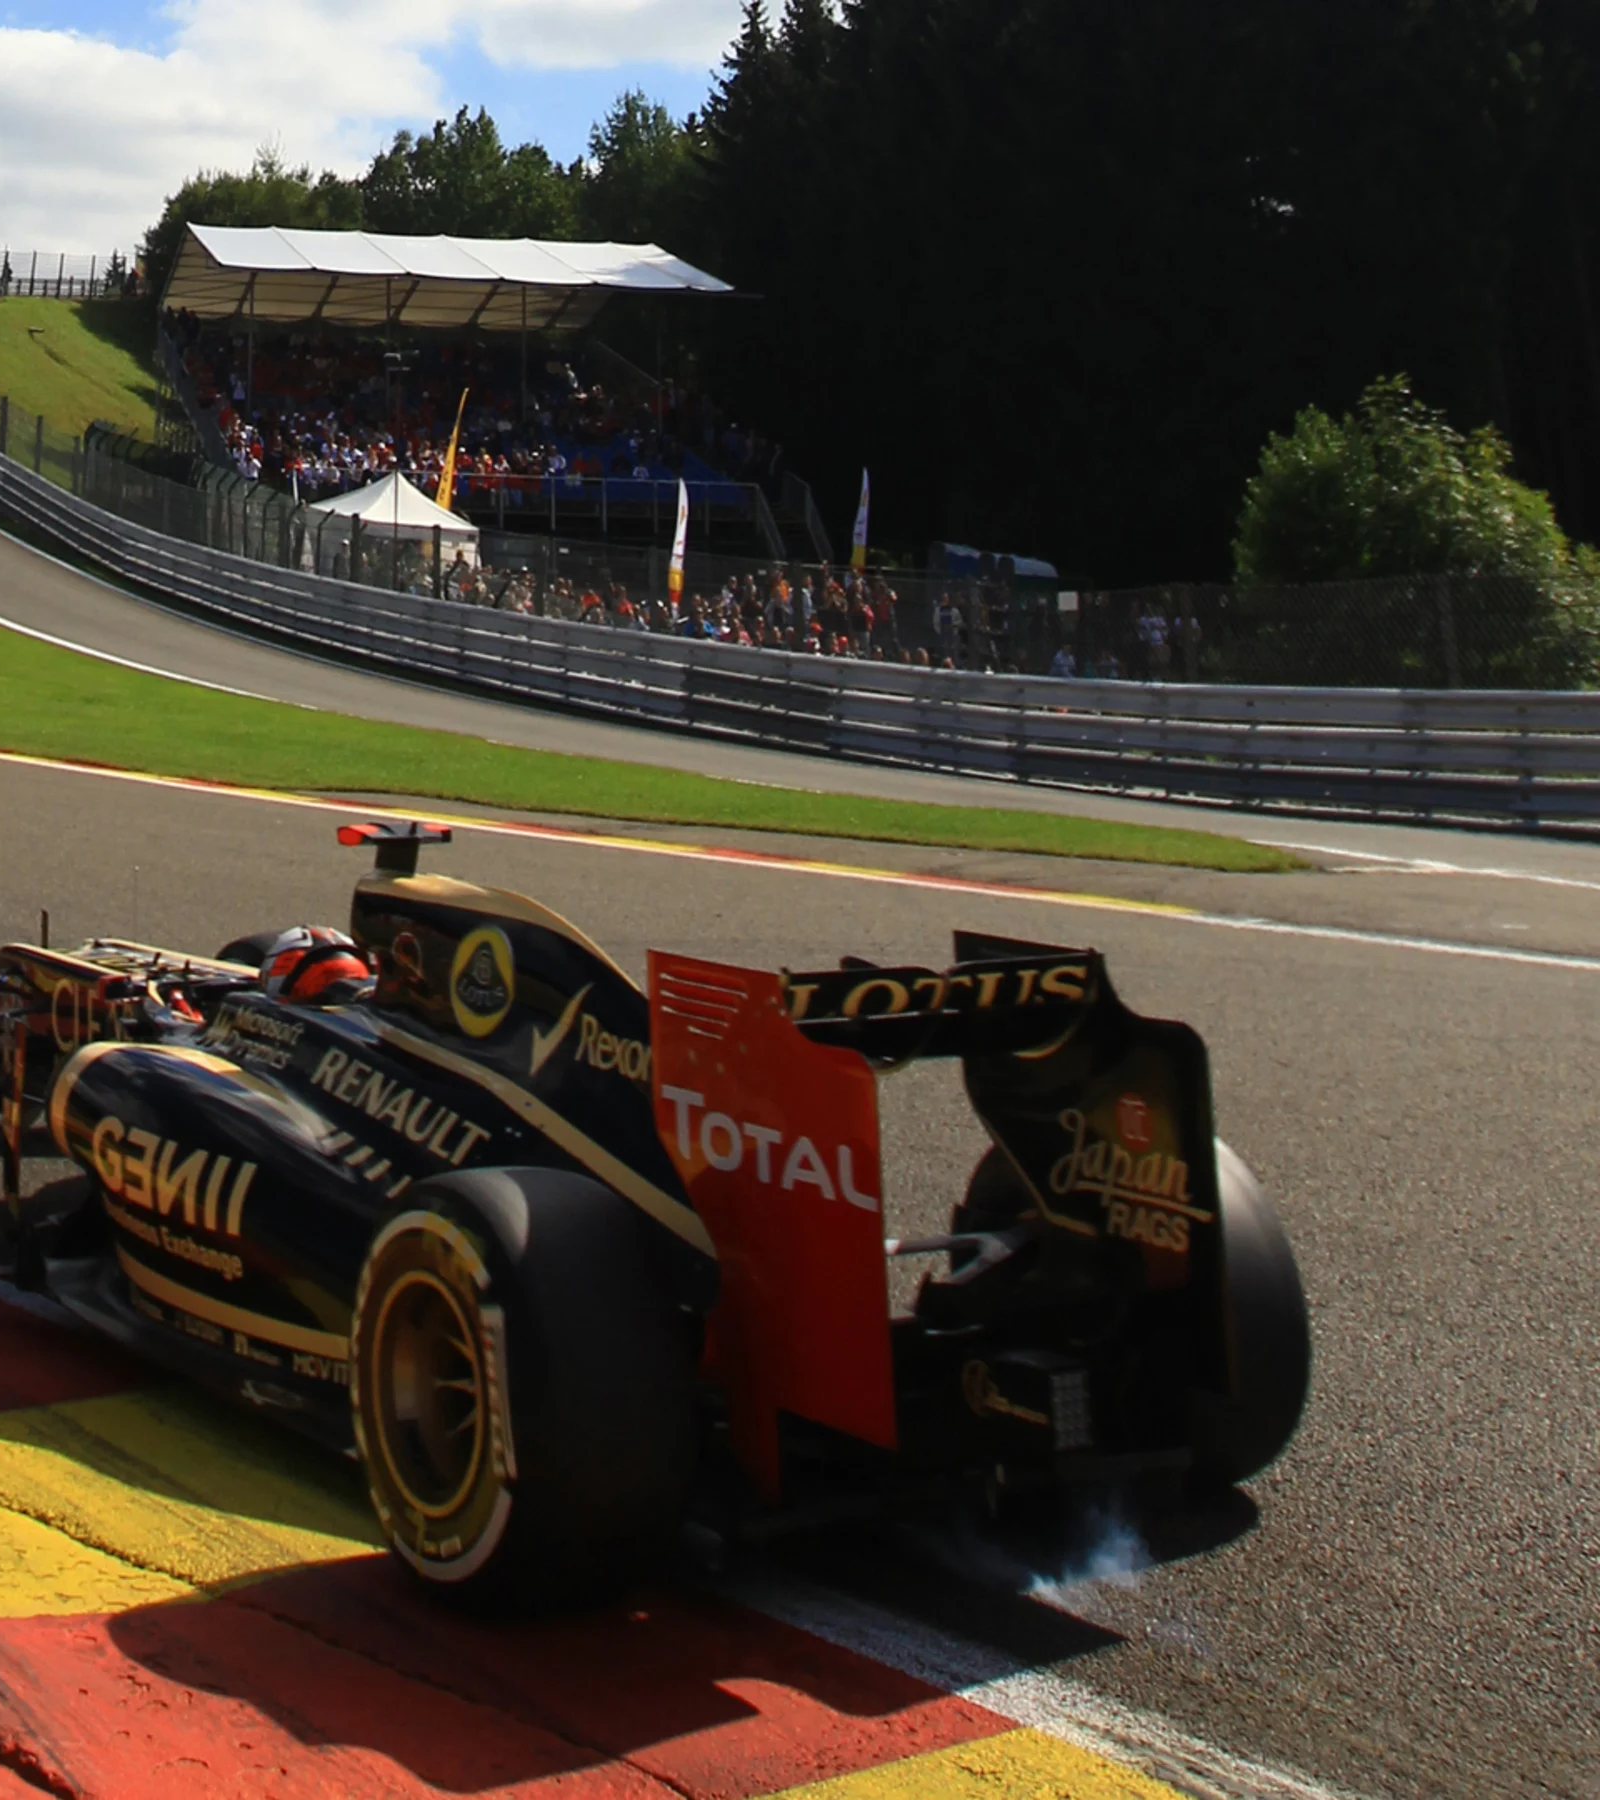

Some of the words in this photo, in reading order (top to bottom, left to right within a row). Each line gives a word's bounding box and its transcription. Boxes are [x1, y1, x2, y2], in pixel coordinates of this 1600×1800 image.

[232, 1004, 305, 1047] Microsoft
[787, 965, 1088, 1019] LOTUS
[310, 1046, 492, 1167] RENAULT
[92, 1116, 258, 1238] GENII
[661, 1084, 879, 1213] TOTAL
[1050, 1108, 1194, 1208] Japan
[159, 1224, 244, 1281] Exchange
[1107, 1201, 1190, 1252] RAGS
